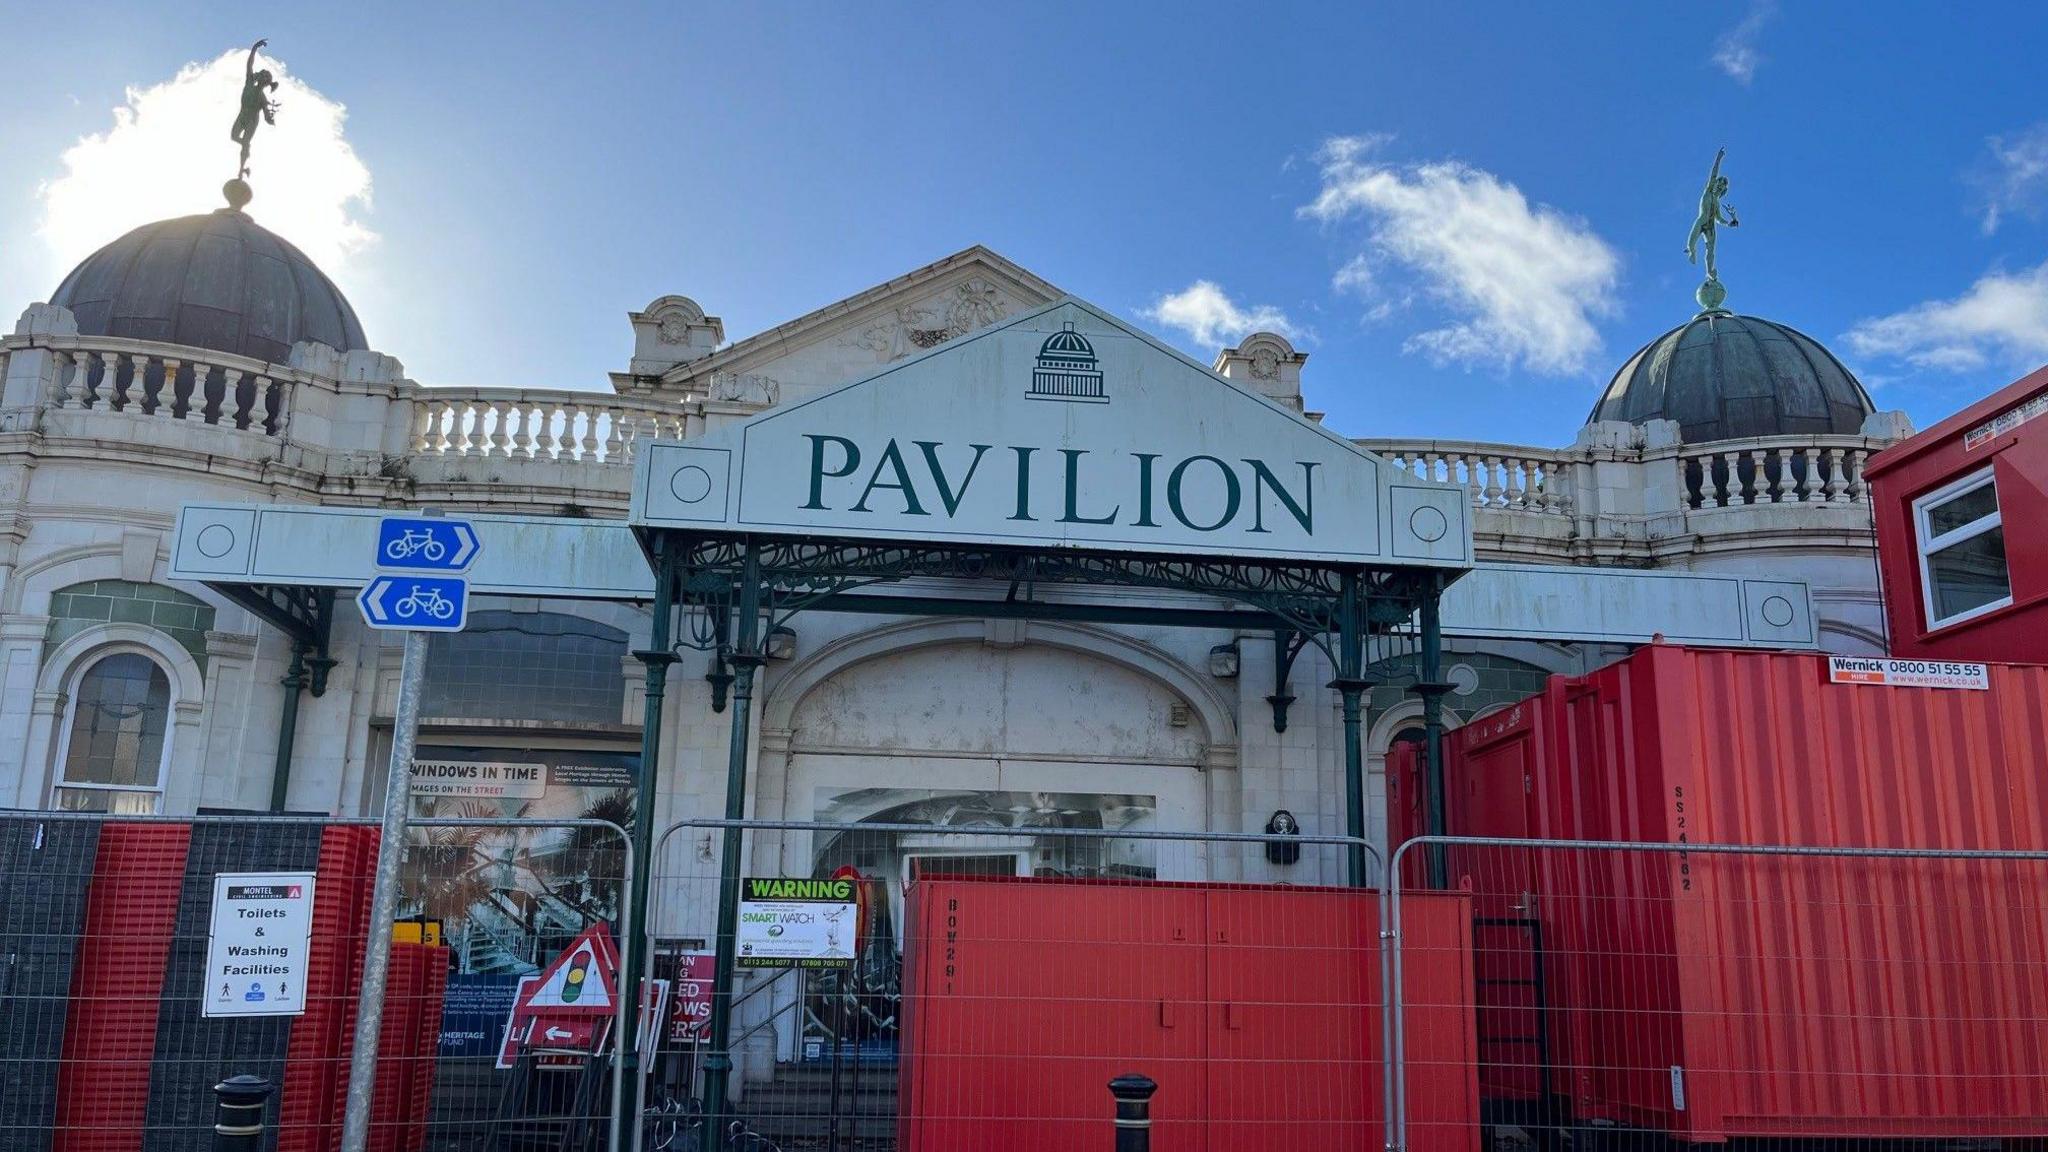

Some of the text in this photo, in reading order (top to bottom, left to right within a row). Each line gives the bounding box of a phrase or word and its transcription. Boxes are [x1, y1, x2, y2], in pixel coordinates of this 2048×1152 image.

[797, 434, 1322, 537] PAVILION
[1833, 658, 1981, 676] Wernick 0800 51 55 55
[1891, 674, 1982, 687] www.wernick.co.uk
[410, 764, 539, 781] WINDOWS IN TIME
[411, 784, 505, 795] MAGES ON THE STREET
[243, 887, 273, 895] MONTEL
[751, 880, 850, 899] WARNING
[237, 908, 287, 919] Toilets
[742, 912, 815, 925] SMART WATCH
[254, 926, 265, 937] &
[228, 946, 289, 958] Washing
[744, 958, 760, 966] 0113
[223, 965, 290, 976] Facilities
[677, 983, 699, 998] ED
[444, 1031, 485, 1039] HERITAGE
[443, 1038, 464, 1046] FUND
